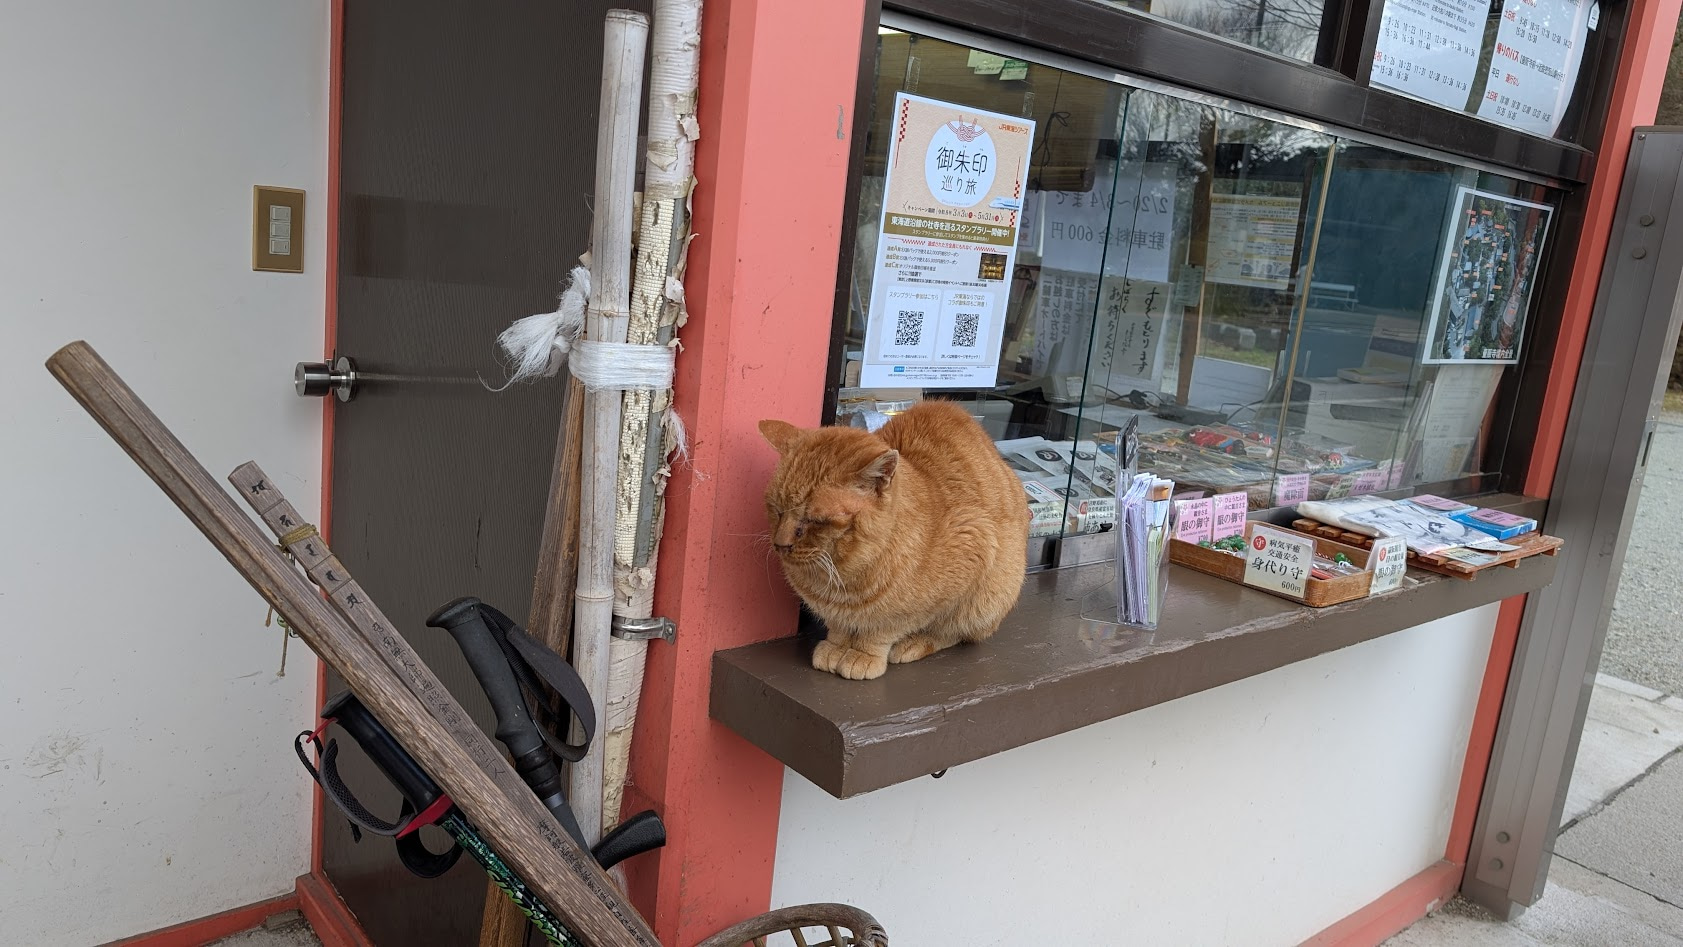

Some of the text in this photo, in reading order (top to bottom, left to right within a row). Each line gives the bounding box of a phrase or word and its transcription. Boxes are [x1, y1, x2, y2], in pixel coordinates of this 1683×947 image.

[1491, 67, 1500, 79] 平日
[936, 146, 988, 177] 御朱印
[940, 174, 978, 196] 巡り旅
[1180, 516, 1210, 531] 眼の御守
[1217, 511, 1245, 525] 眼の御守
[1269, 538, 1301, 555] 病気平癒
[1267, 549, 1299, 564] 交通安全
[1251, 556, 1303, 582] 身代り守
[1281, 579, 1301, 593] 600円
